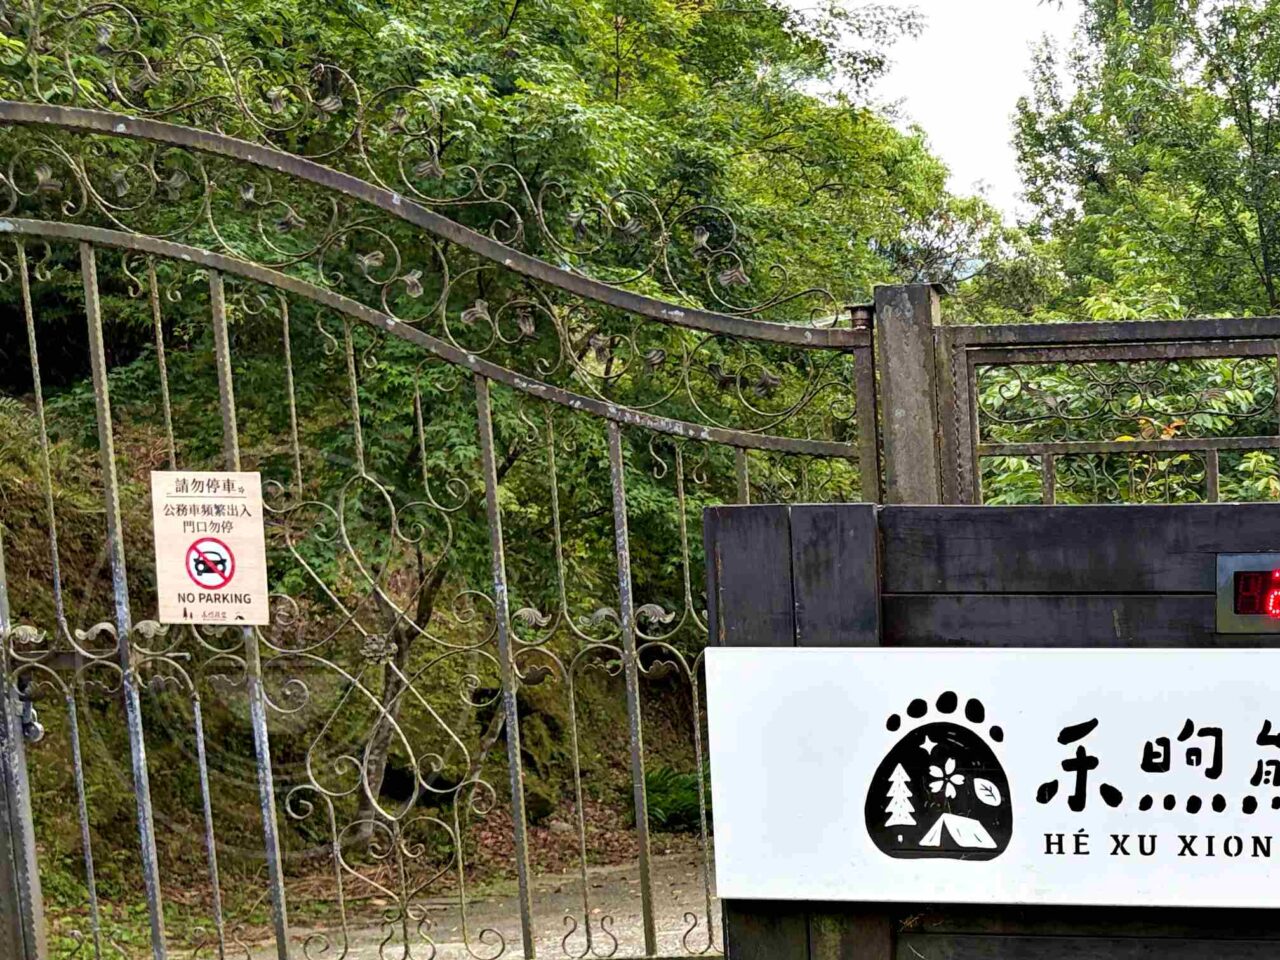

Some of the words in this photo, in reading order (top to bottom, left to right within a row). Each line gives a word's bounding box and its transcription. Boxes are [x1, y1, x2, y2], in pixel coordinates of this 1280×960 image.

[175, 478, 236, 494] 請勿停車
[163, 503, 252, 517] 公務車頻繁出入
[183, 520, 234, 534] 門口勿停
[177, 592, 196, 604] NO
[198, 592, 252, 605] PARKING
[1043, 828, 1090, 855] HÉ
[1110, 834, 1158, 856] XU
